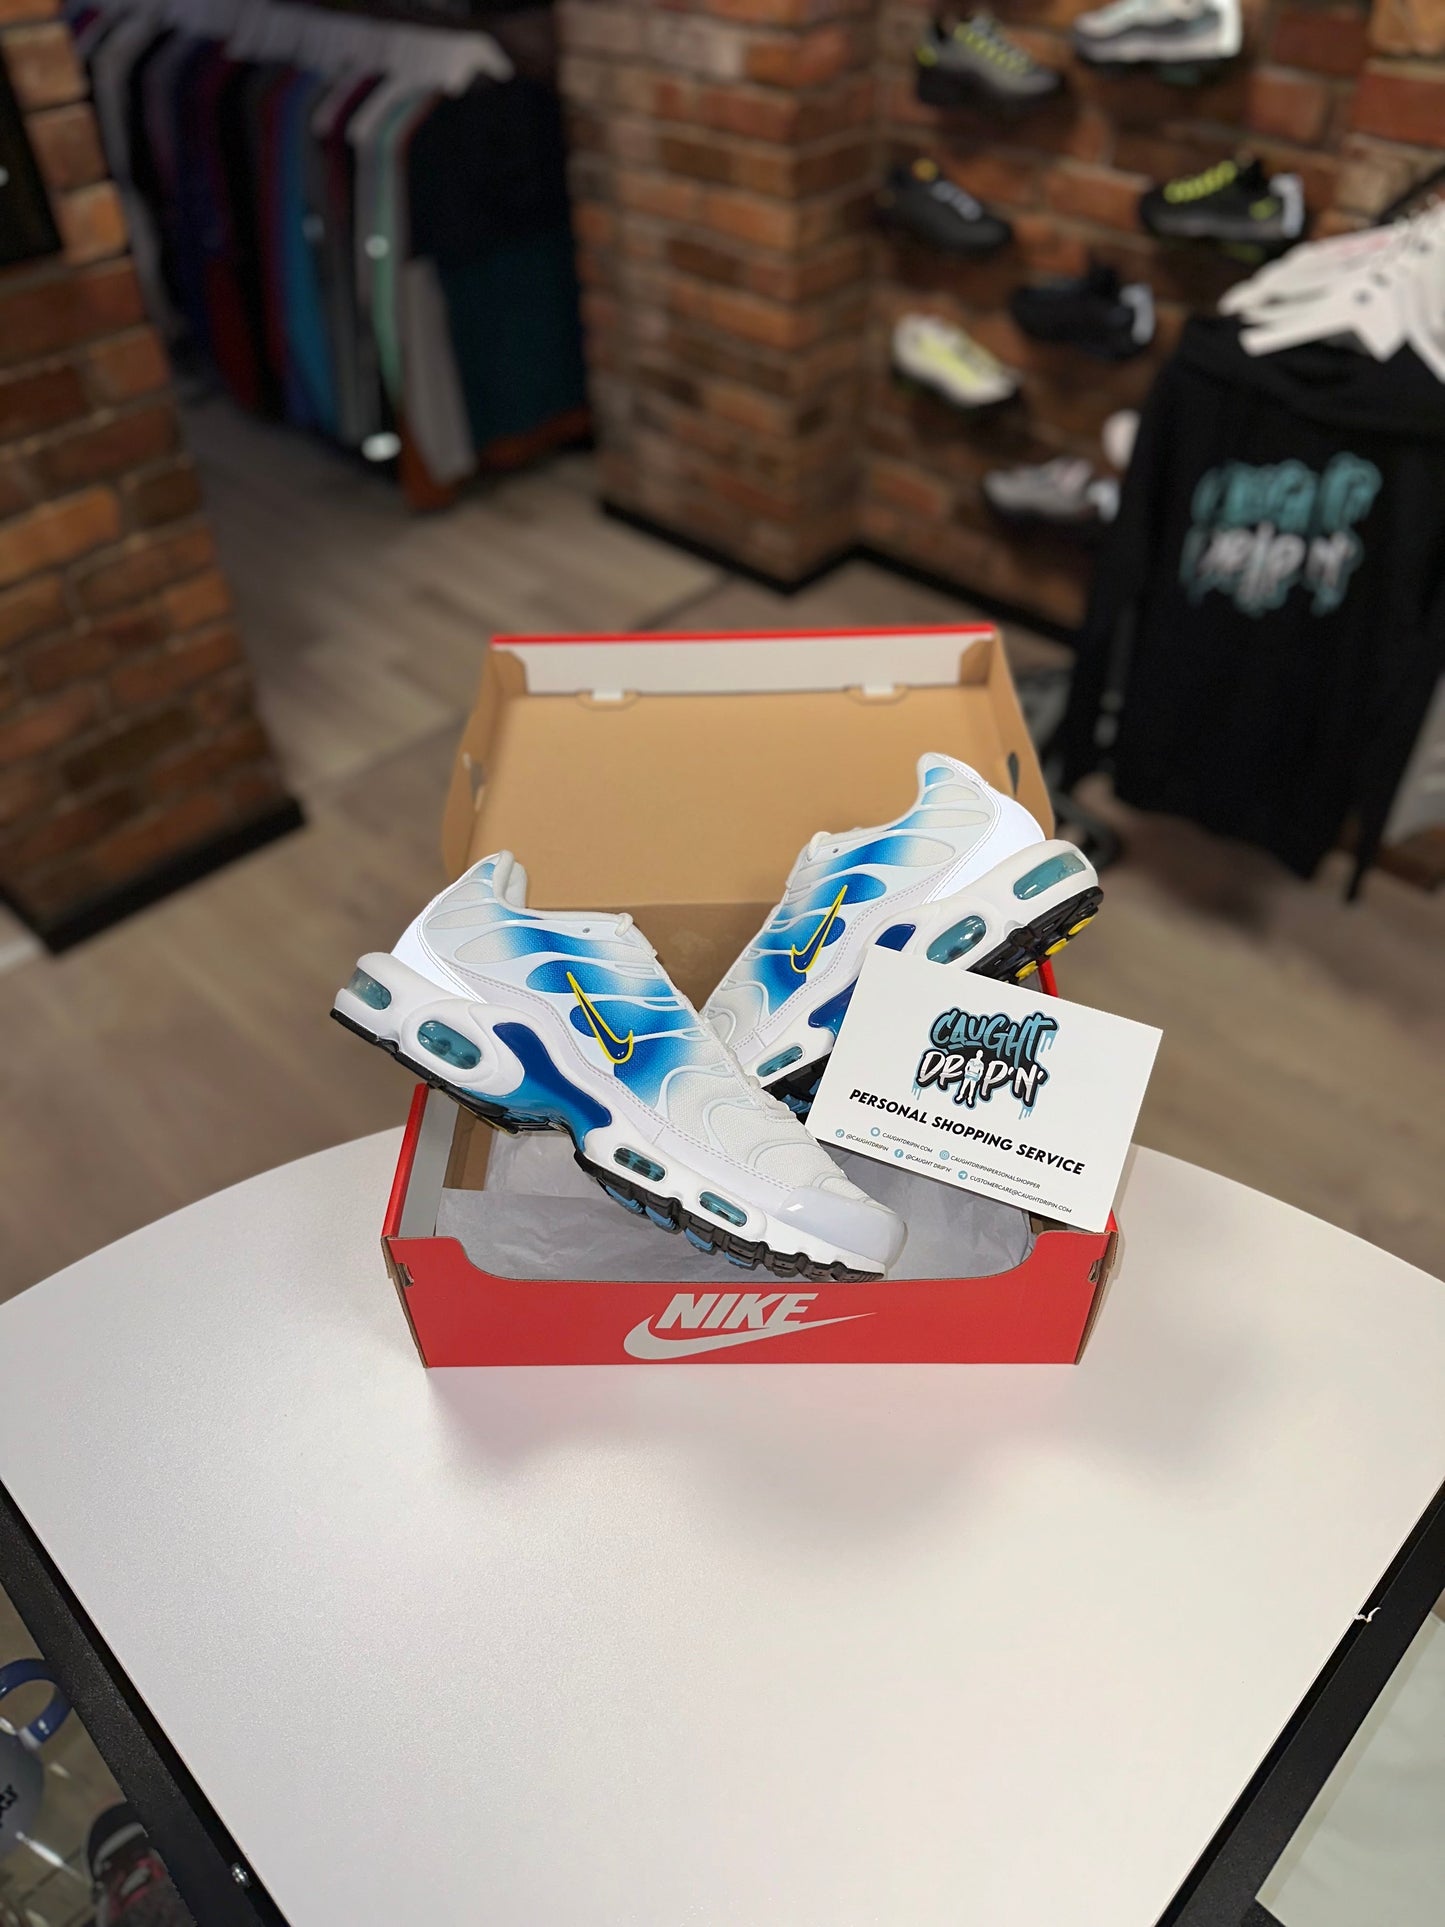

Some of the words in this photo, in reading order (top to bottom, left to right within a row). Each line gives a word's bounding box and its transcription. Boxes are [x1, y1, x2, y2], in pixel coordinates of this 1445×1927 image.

[932, 1008, 1055, 1070] CAUGHT
[849, 1088, 928, 1124] PERSONAL
[931, 1116, 1013, 1151] SHOPPING
[1015, 1143, 1086, 1176] SERVICE
[905, 1154, 933, 1167] @CAUGHT
[655, 1293, 819, 1329] NIKE
